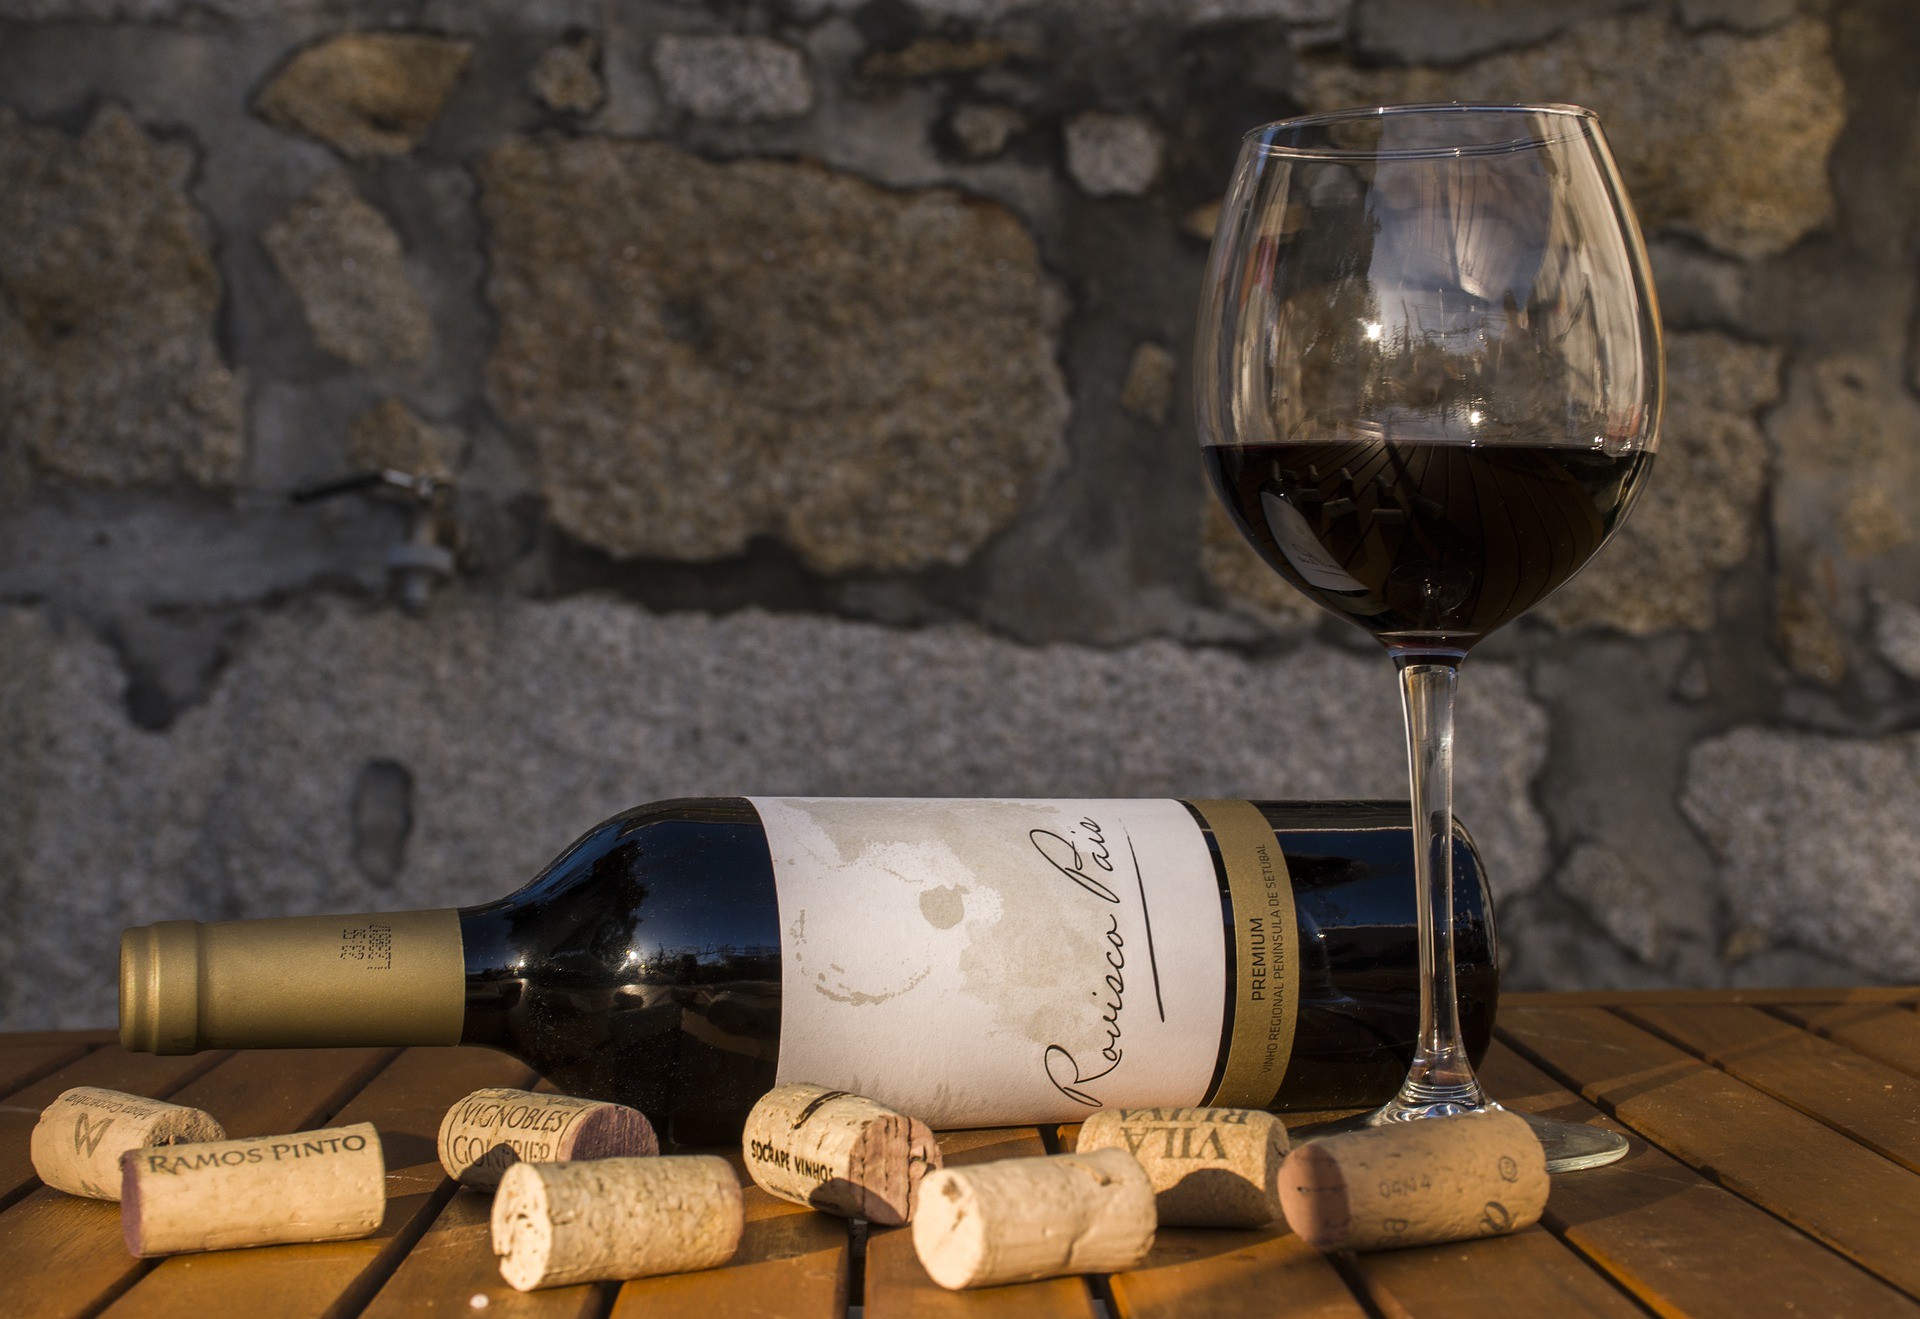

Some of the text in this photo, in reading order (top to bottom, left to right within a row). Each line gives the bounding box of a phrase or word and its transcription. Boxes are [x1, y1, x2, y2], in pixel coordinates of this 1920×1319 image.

[1029, 817, 1125, 1108] Rovisco Pais
[1250, 918, 1267, 1002] PREMIUM
[1255, 843, 1284, 1073] VINHO REGIONAL PENÍNSULA DE SETÚBAL
[460, 1102, 571, 1133] VIGNOBLES
[147, 1134, 367, 1175] RAMOS PINTO
[1119, 1126, 1231, 1162] VILA
[794, 1155, 835, 1186] VINHOS
